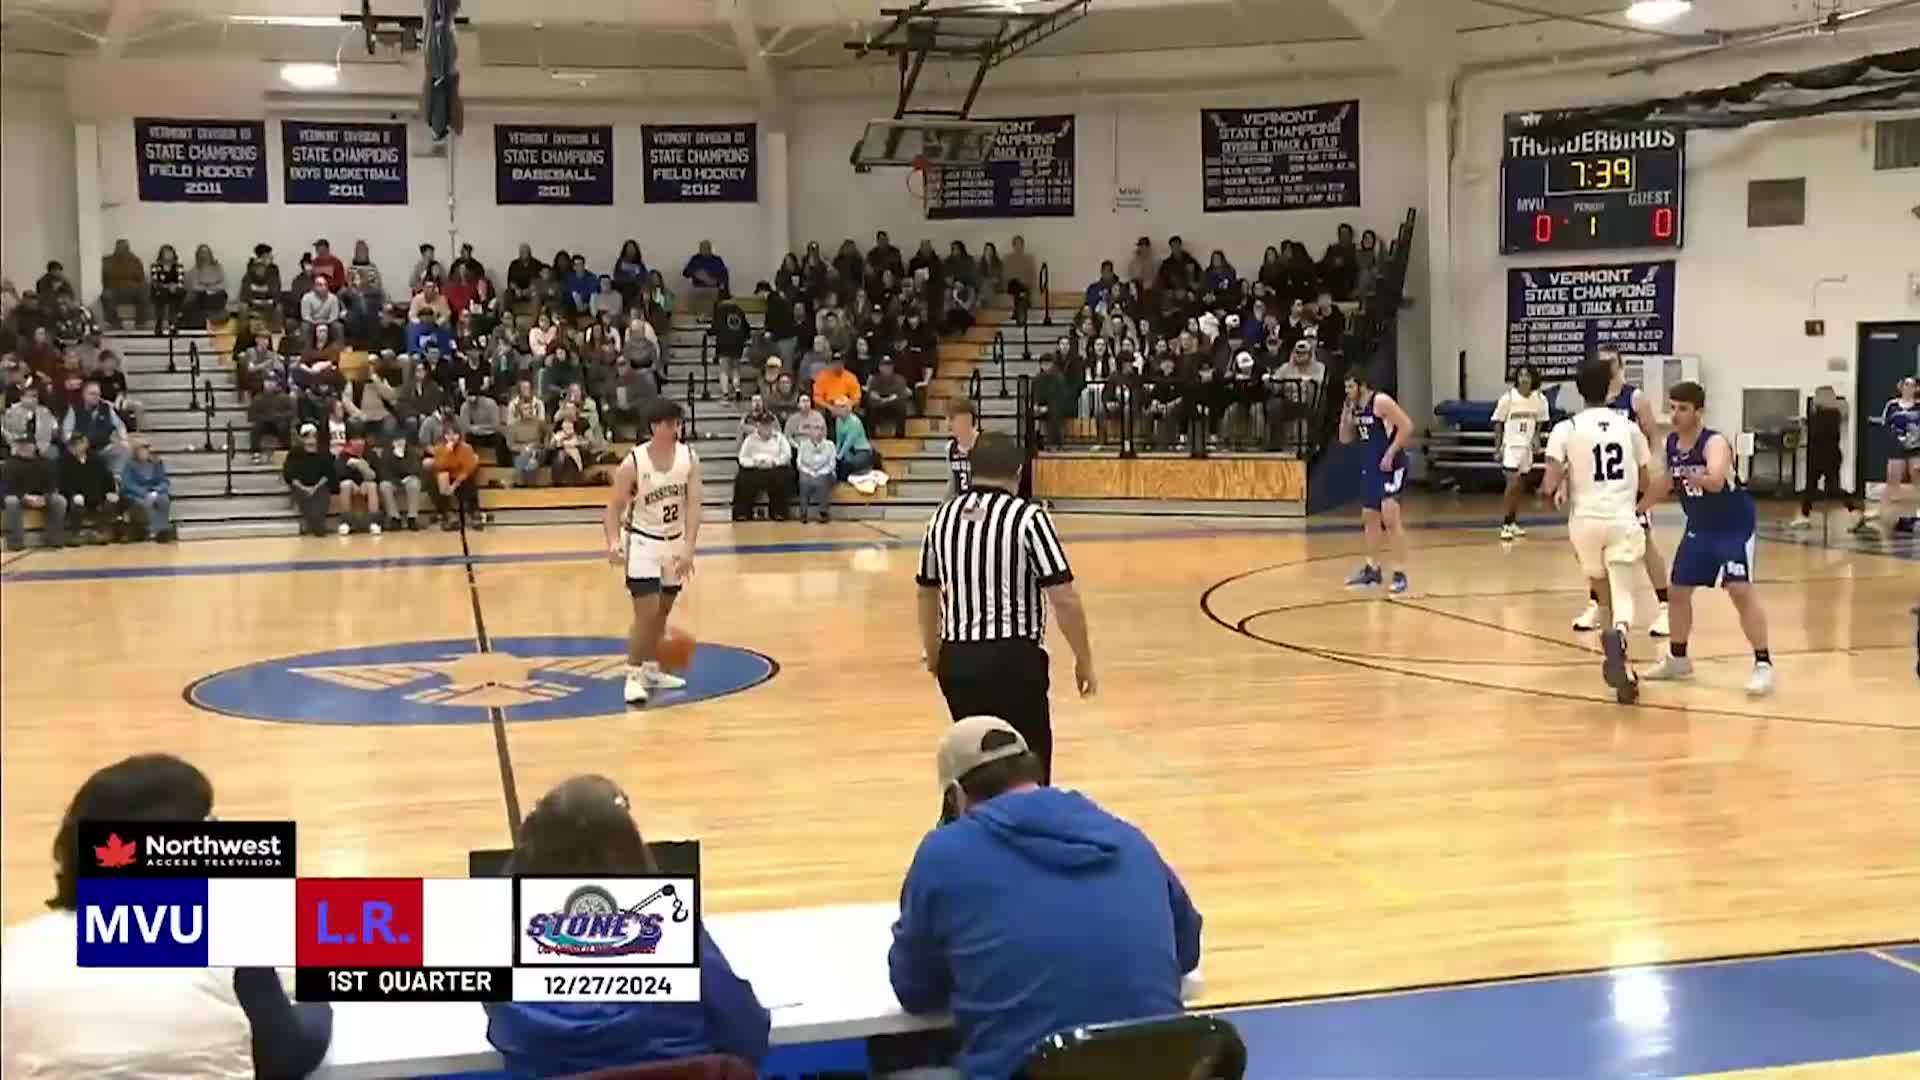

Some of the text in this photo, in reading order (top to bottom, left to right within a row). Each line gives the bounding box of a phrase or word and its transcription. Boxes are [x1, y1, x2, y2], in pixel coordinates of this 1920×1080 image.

[1243, 110, 1319, 126] VERMONT
[1219, 120, 1341, 140] STATE CHAMPIONS
[145, 143, 257, 160] STATE CHAMPIONS
[292, 148, 399, 164] STATE CHAMPIONS
[504, 149, 604, 165] STATE CHAMPIONS
[650, 148, 749, 164] STATE CHAMPIONS
[149, 163, 255, 178] FIELD HOCKEY
[290, 167, 400, 180] BOYS BASKETBALL
[512, 169, 597, 181] BASEBALL
[653, 168, 747, 181] FIELD HOCKEY
[1571, 158, 1631, 189] 7:39
[184, 182, 223, 195] 2011
[328, 184, 365, 197] 2011
[681, 184, 720, 196] 2012
[1517, 198, 1545, 212] MVU
[1628, 190, 1672, 206] GUEST
[1536, 214, 1552, 243] 0
[1655, 208, 1673, 237] 0
[1550, 269, 1633, 285] VERMONT
[1525, 283, 1656, 302] STATE CHAMPIONS
[1527, 303, 1566, 316] DIVISION
[1582, 302, 1612, 315] TRACK
[1626, 299, 1654, 313] FIELD
[1592, 442, 1624, 482] 12
[663, 503, 679, 524] 22
